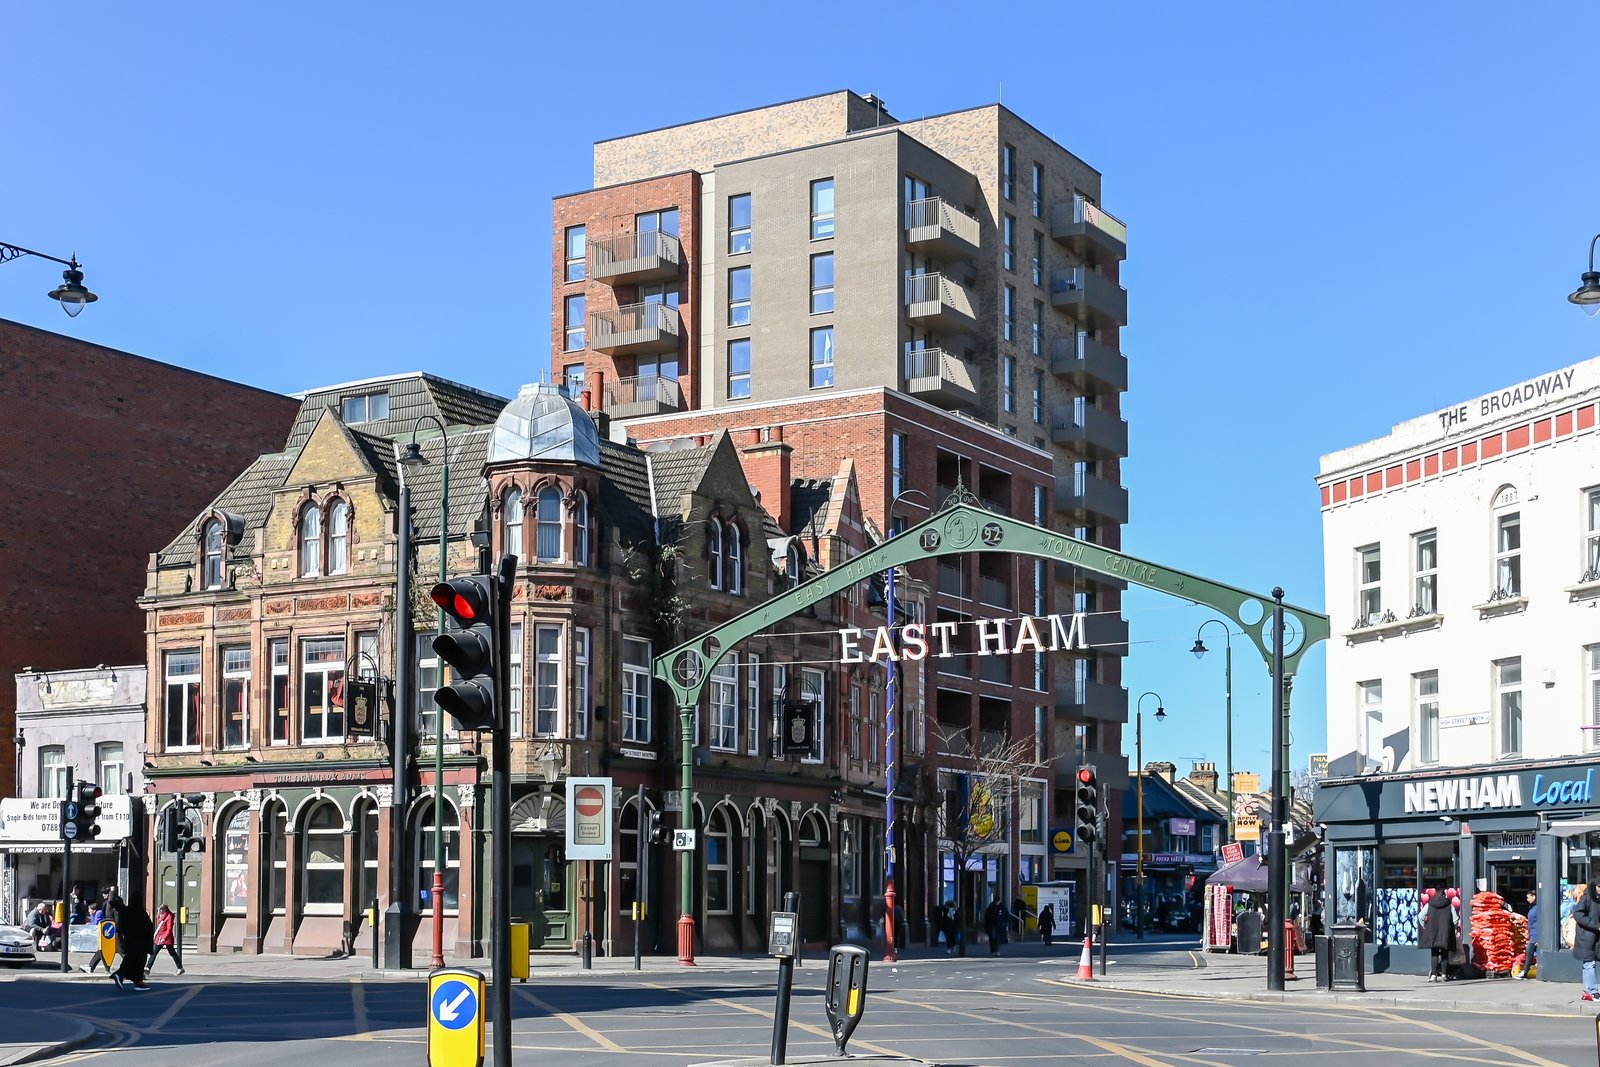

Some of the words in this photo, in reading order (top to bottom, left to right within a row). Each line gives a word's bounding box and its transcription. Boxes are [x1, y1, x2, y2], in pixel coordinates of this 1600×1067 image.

[1439, 406, 1467, 428] THE
[1481, 369, 1575, 416] BROADWAY
[1501, 491, 1518, 503] 1887
[922, 533, 939, 547] 19
[983, 527, 1001, 541] 92
[1047, 536, 1085, 562] TOWN
[1104, 554, 1157, 583] CENTRE
[796, 577, 830, 606] EAST
[845, 554, 877, 580] HAM
[838, 621, 958, 664] EAST
[975, 612, 1088, 656] HAM
[1404, 775, 1522, 814] NEWHAM
[1532, 768, 1595, 804] Local
[30, 801, 39, 810] We
[115, 812, 130, 820] £110
[1502, 832, 1536, 846] Welcome
[1058, 899, 1069, 908] SCAN
